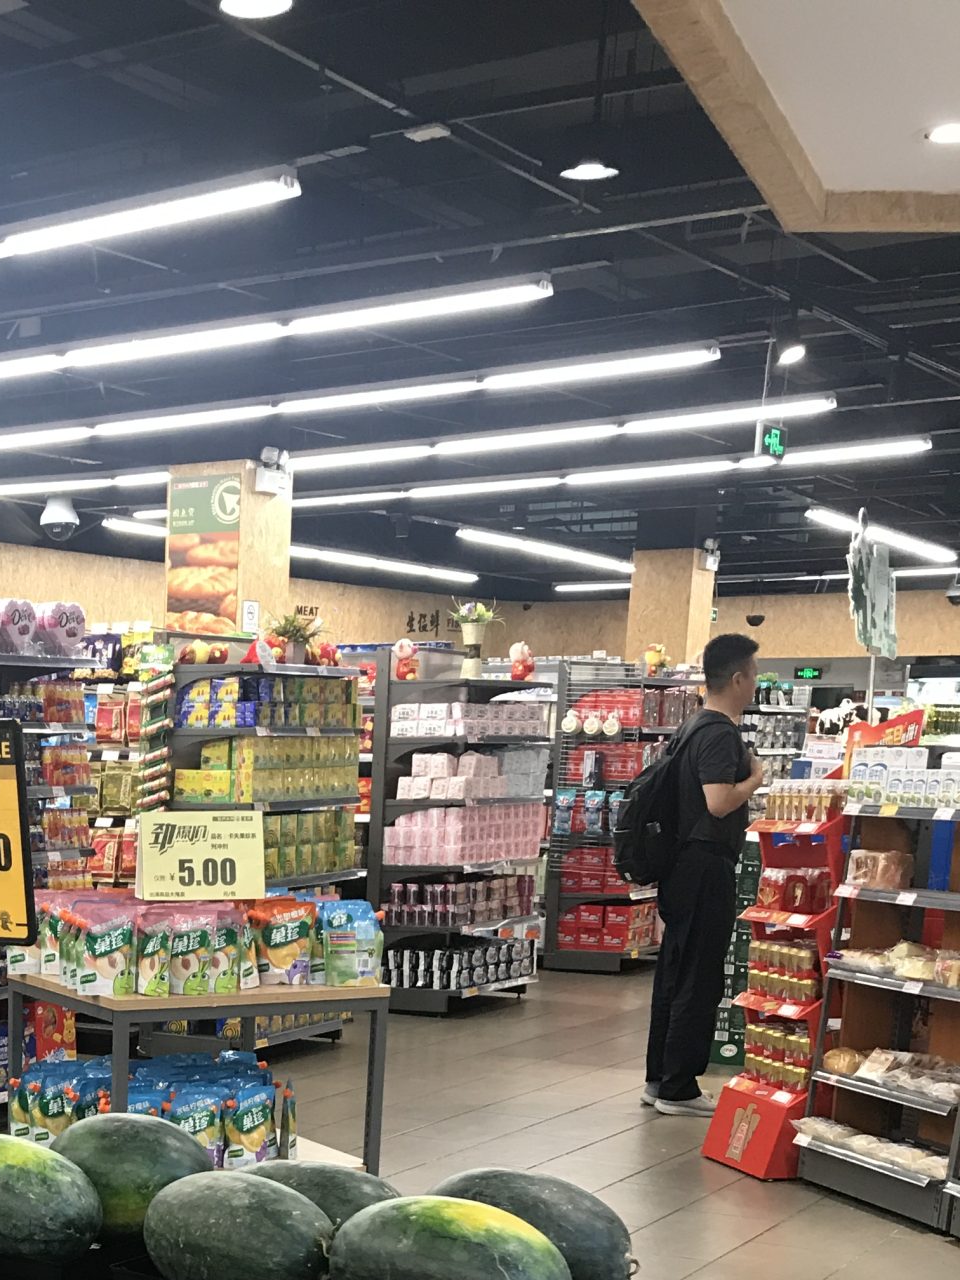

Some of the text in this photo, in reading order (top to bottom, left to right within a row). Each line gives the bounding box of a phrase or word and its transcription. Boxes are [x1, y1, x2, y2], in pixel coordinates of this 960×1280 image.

[11, 609, 34, 625] Dove
[297, 605, 319, 616] MEAT
[58, 612, 82, 628] Dove
[178, 857, 237, 887] 5.00
